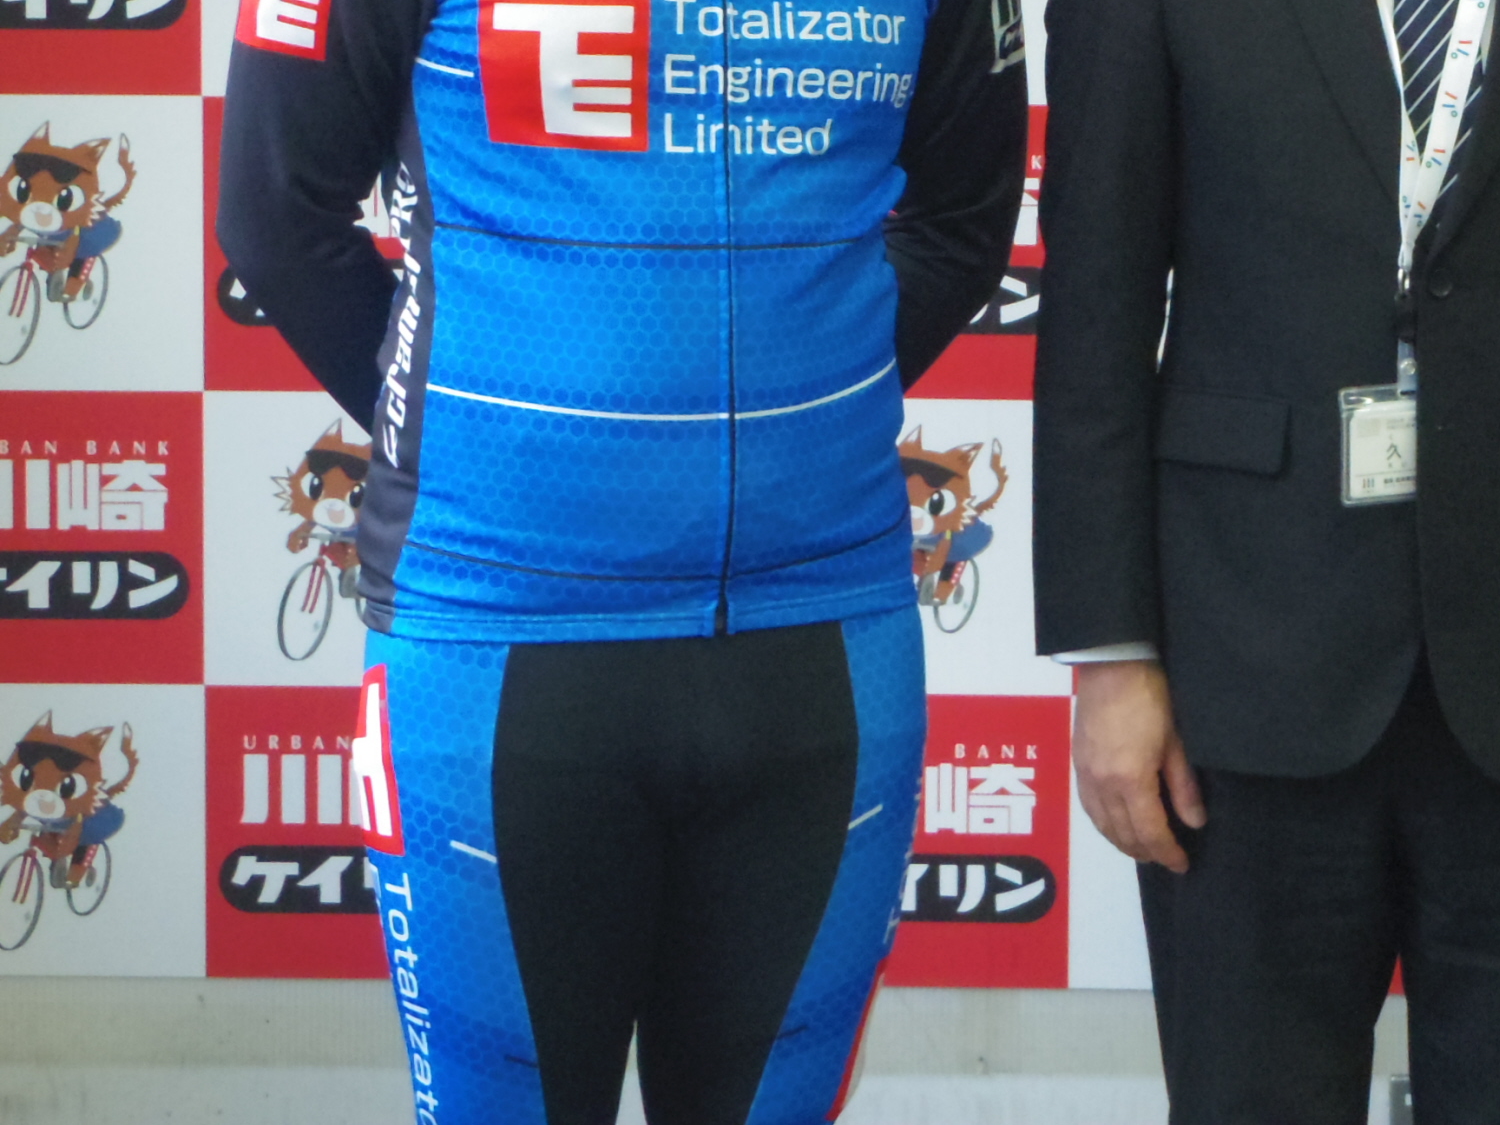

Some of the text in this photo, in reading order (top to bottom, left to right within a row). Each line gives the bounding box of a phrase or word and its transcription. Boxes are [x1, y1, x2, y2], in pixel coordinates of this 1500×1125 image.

[664, 53, 912, 108] Engineering
[664, 113, 833, 155] Limited
[0, 440, 168, 455] BAN BANK
[0, 560, 178, 609] イリン
[244, 735, 349, 750] URBAN
[955, 744, 1037, 759] BANK
[241, 754, 352, 825] 川
[924, 763, 1036, 834] 崎
[900, 863, 1045, 912] イリン
